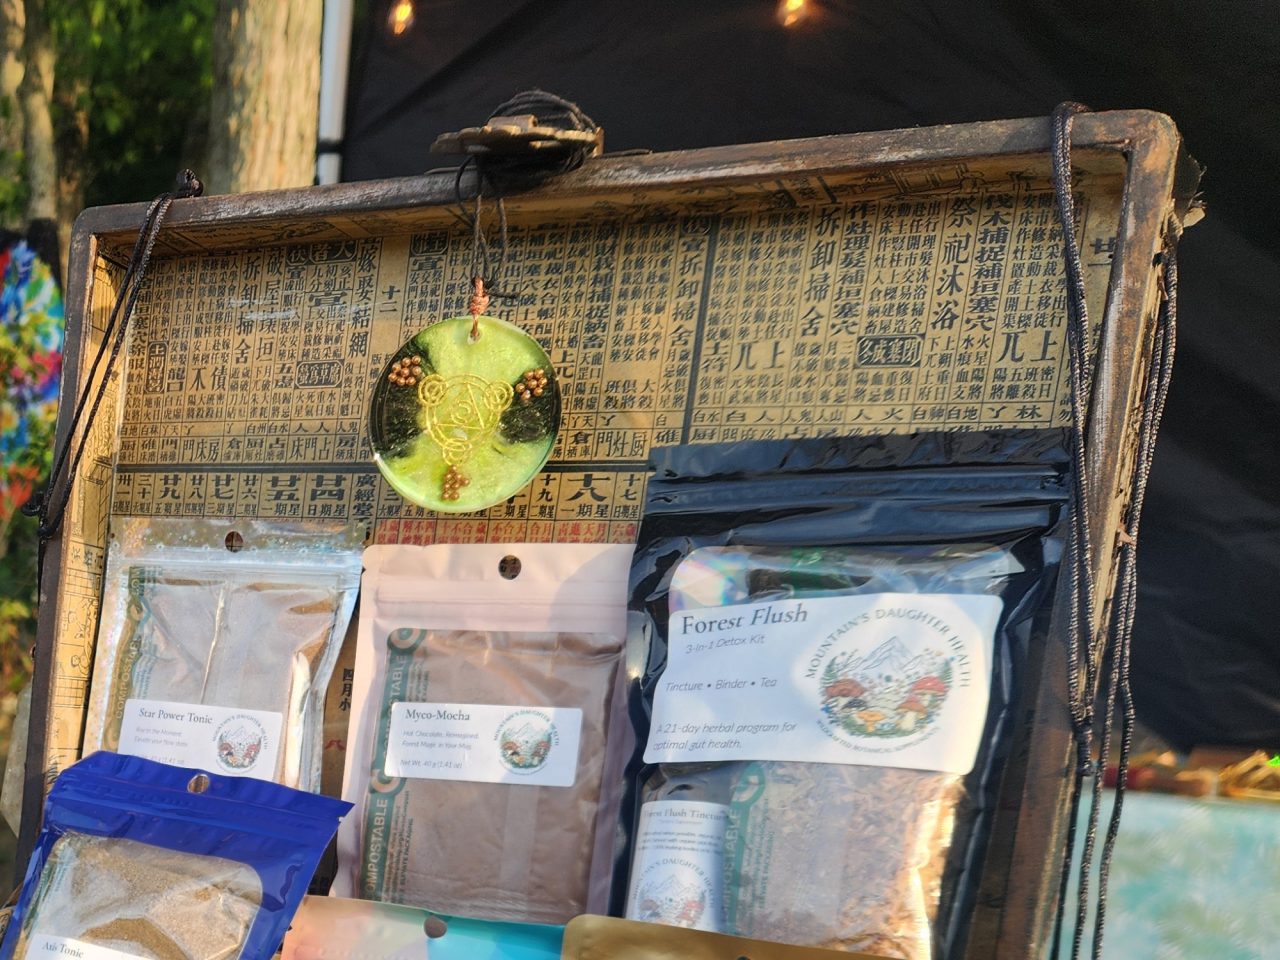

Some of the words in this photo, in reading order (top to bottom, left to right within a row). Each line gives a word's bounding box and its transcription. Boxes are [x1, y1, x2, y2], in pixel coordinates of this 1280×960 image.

[681, 614, 745, 636] Forest
[749, 602, 809, 627] Flush
[875, 607, 951, 636] DAUGHTER
[716, 637, 747, 650] Detox
[749, 633, 766, 646] Kit
[665, 681, 704, 693] Tincture
[715, 678, 748, 691] Binder
[761, 677, 778, 689] Tea
[138, 707, 156, 719] Star
[157, 709, 185, 722] Power
[187, 712, 213, 725] Tonic
[404, 708, 471, 724] Myco-Mocha
[702, 721, 736, 734] herbal
[735, 723, 780, 737] program
[781, 720, 799, 733] for
[652, 740, 688, 752] optimal
[689, 740, 707, 752] gut
[59, 942, 85, 959] Tonic
